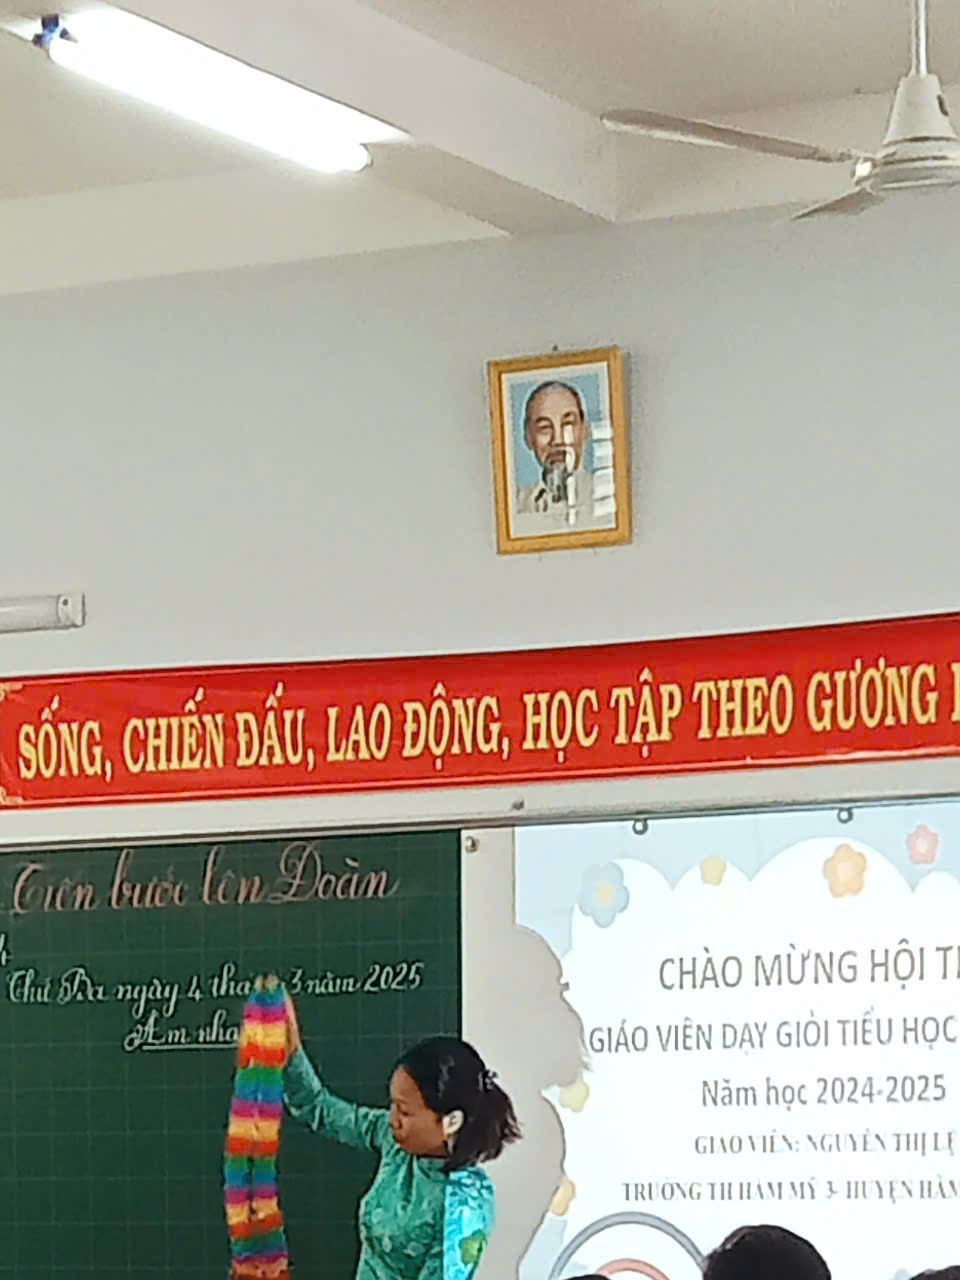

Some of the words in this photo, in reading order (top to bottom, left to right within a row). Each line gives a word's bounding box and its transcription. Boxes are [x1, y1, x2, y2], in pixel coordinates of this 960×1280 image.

[18, 694, 112, 783] SỐNG,
[122, 687, 226, 773] CHIẾN
[235, 681, 316, 772] ĐẤU,
[326, 702, 392, 763] LAO
[402, 681, 511, 771] ĐỘNG,
[522, 688, 599, 764] HỌC
[609, 666, 683, 758] TẬP
[692, 673, 794, 740] THEO
[806, 656, 939, 732] GƯƠNG
[187, 974, 202, 1002] 4
[289, 967, 304, 994] 3
[362, 961, 425, 992] 2025
[658, 946, 743, 990] CHÀO
[754, 942, 858, 987] MỪNG
[870, 938, 925, 991] HỘI
[935, 945, 960, 981] T
[589, 1018, 649, 1054] GIÁO
[655, 1016, 713, 1052] VIÊN
[721, 1020, 768, 1055] DẠY
[776, 1009, 830, 1048] GIỎI
[837, 1005, 893, 1047] TIỂU
[902, 1014, 958, 1050] HỌC
[701, 1078, 758, 1108] Năm
[765, 1076, 809, 1113] học
[815, 1073, 947, 1105] 2024-2025
